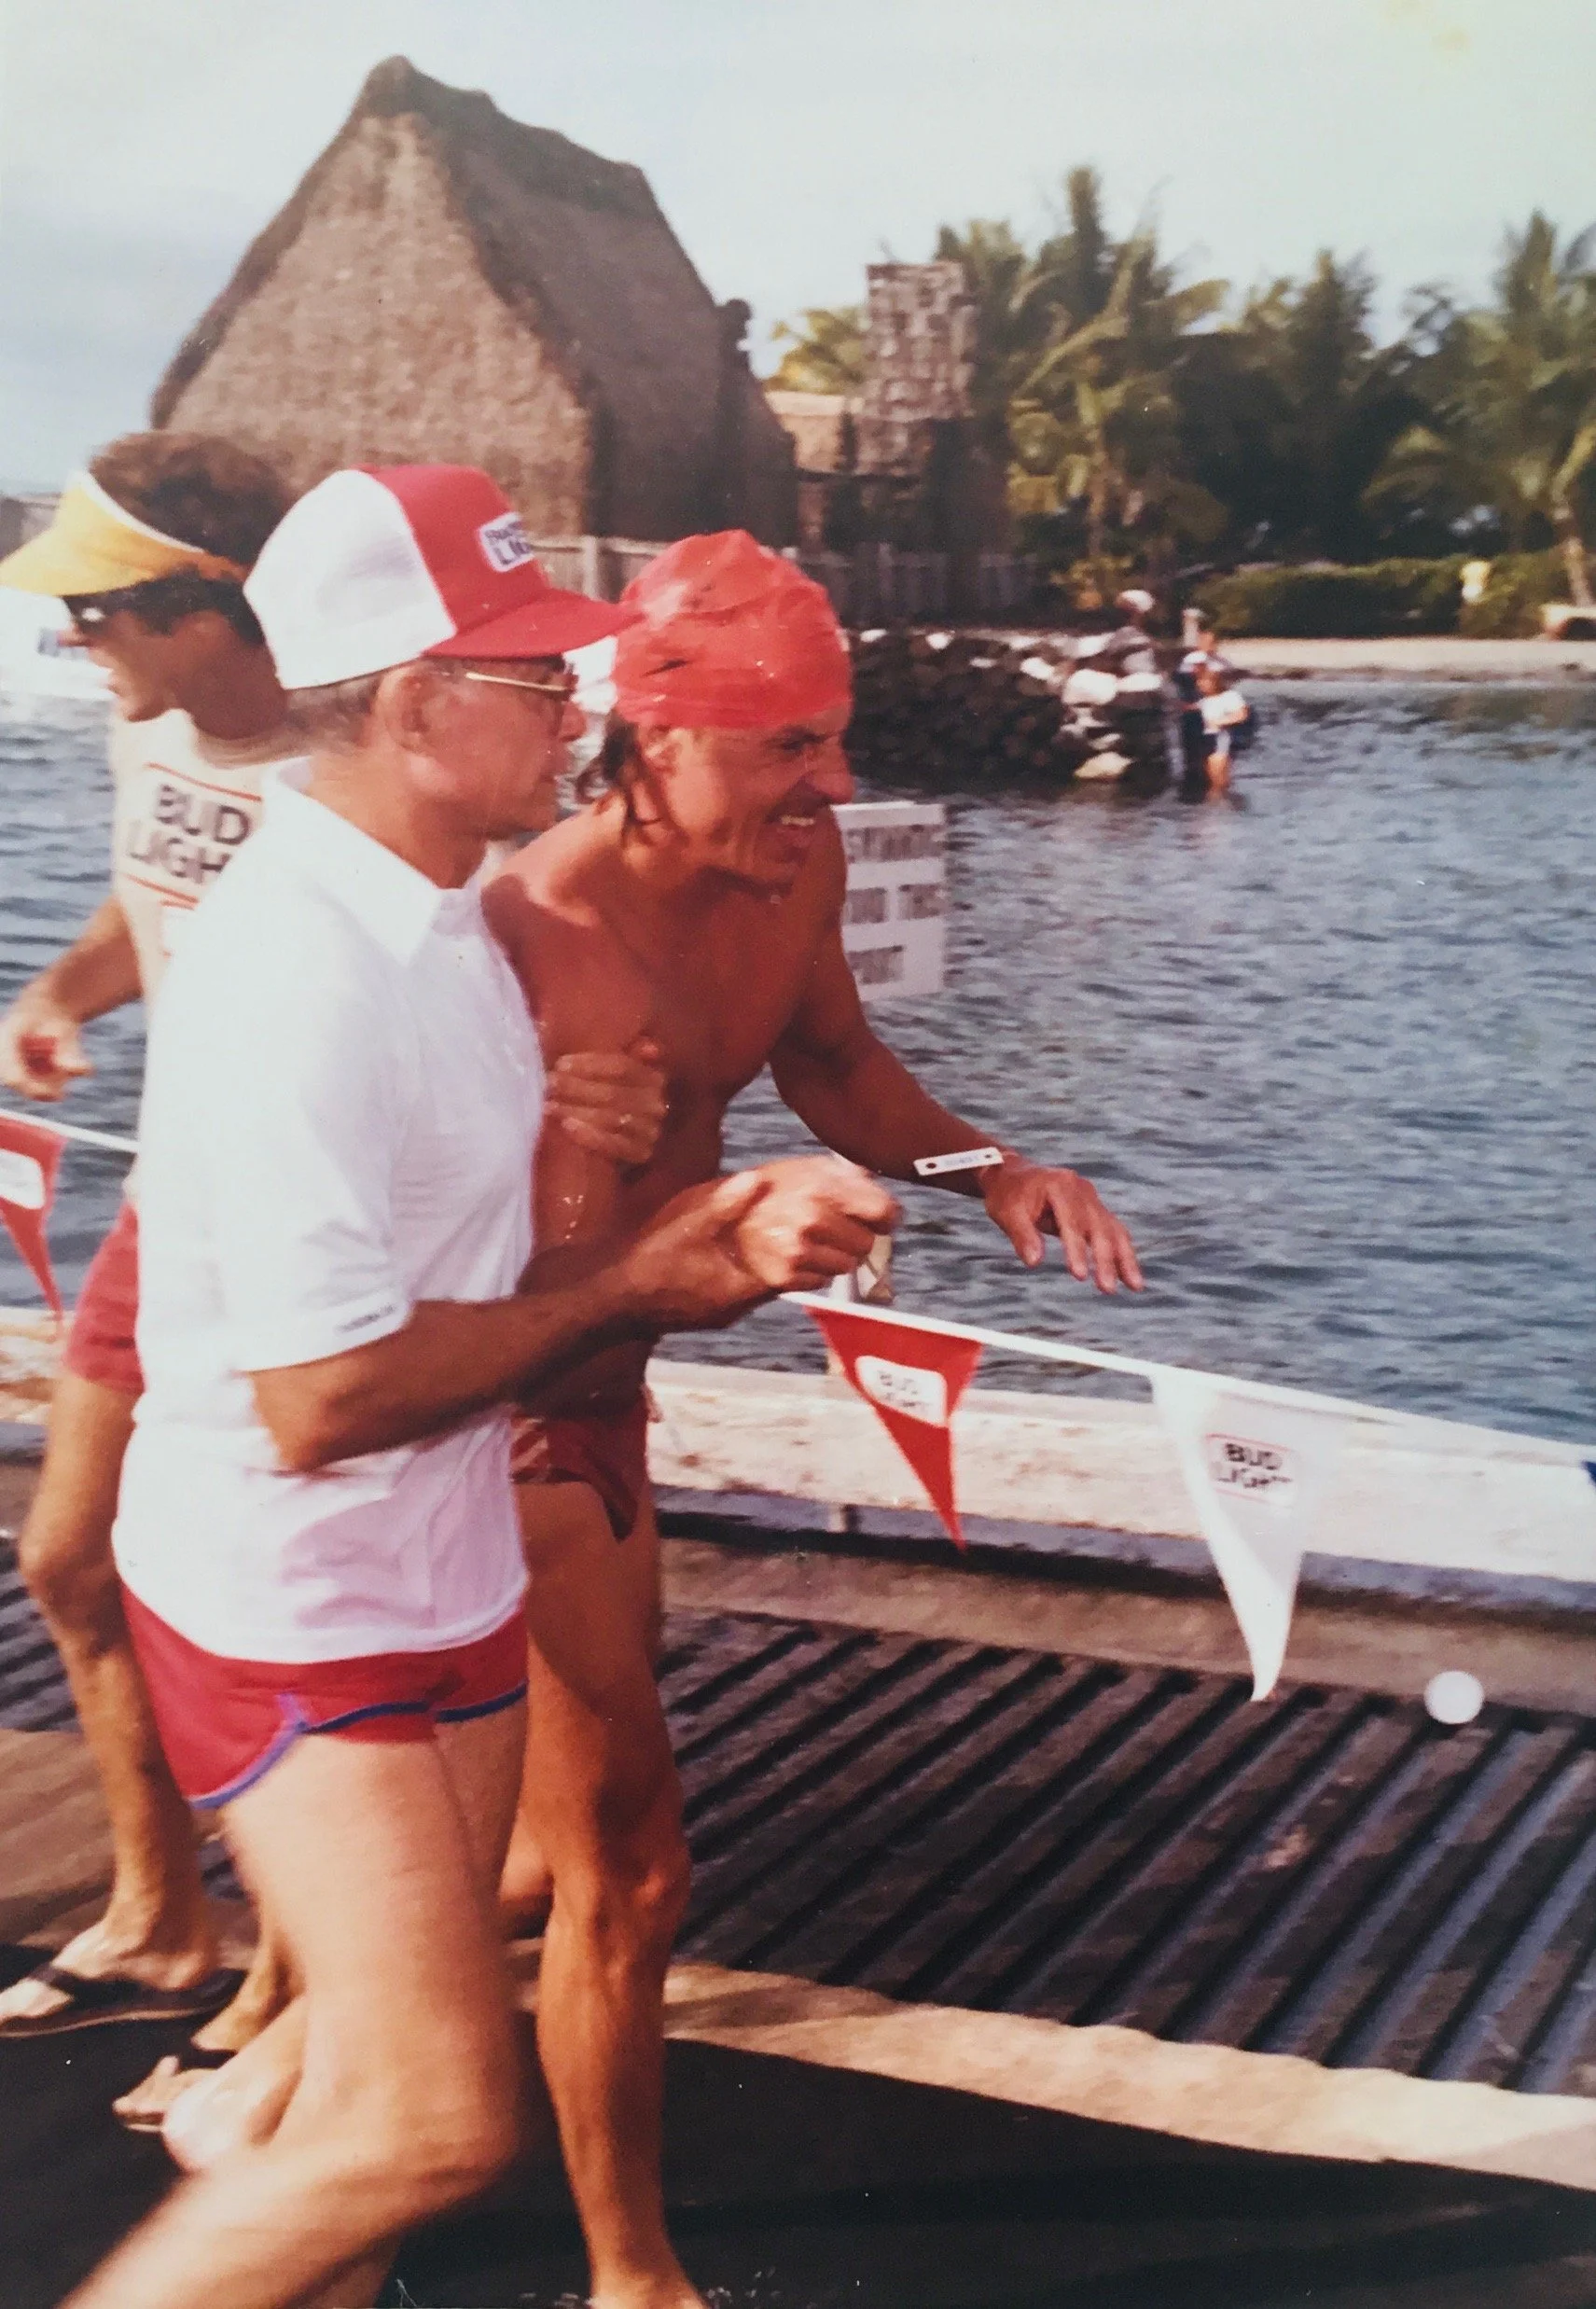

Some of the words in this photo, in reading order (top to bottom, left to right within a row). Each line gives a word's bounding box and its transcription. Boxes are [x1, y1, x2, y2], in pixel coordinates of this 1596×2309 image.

[155, 782, 252, 846] BUD
[125, 819, 233, 884] LIGH
[1209, 1461, 1293, 1493] LIGHT
[1224, 1442, 1284, 1471] BUD
